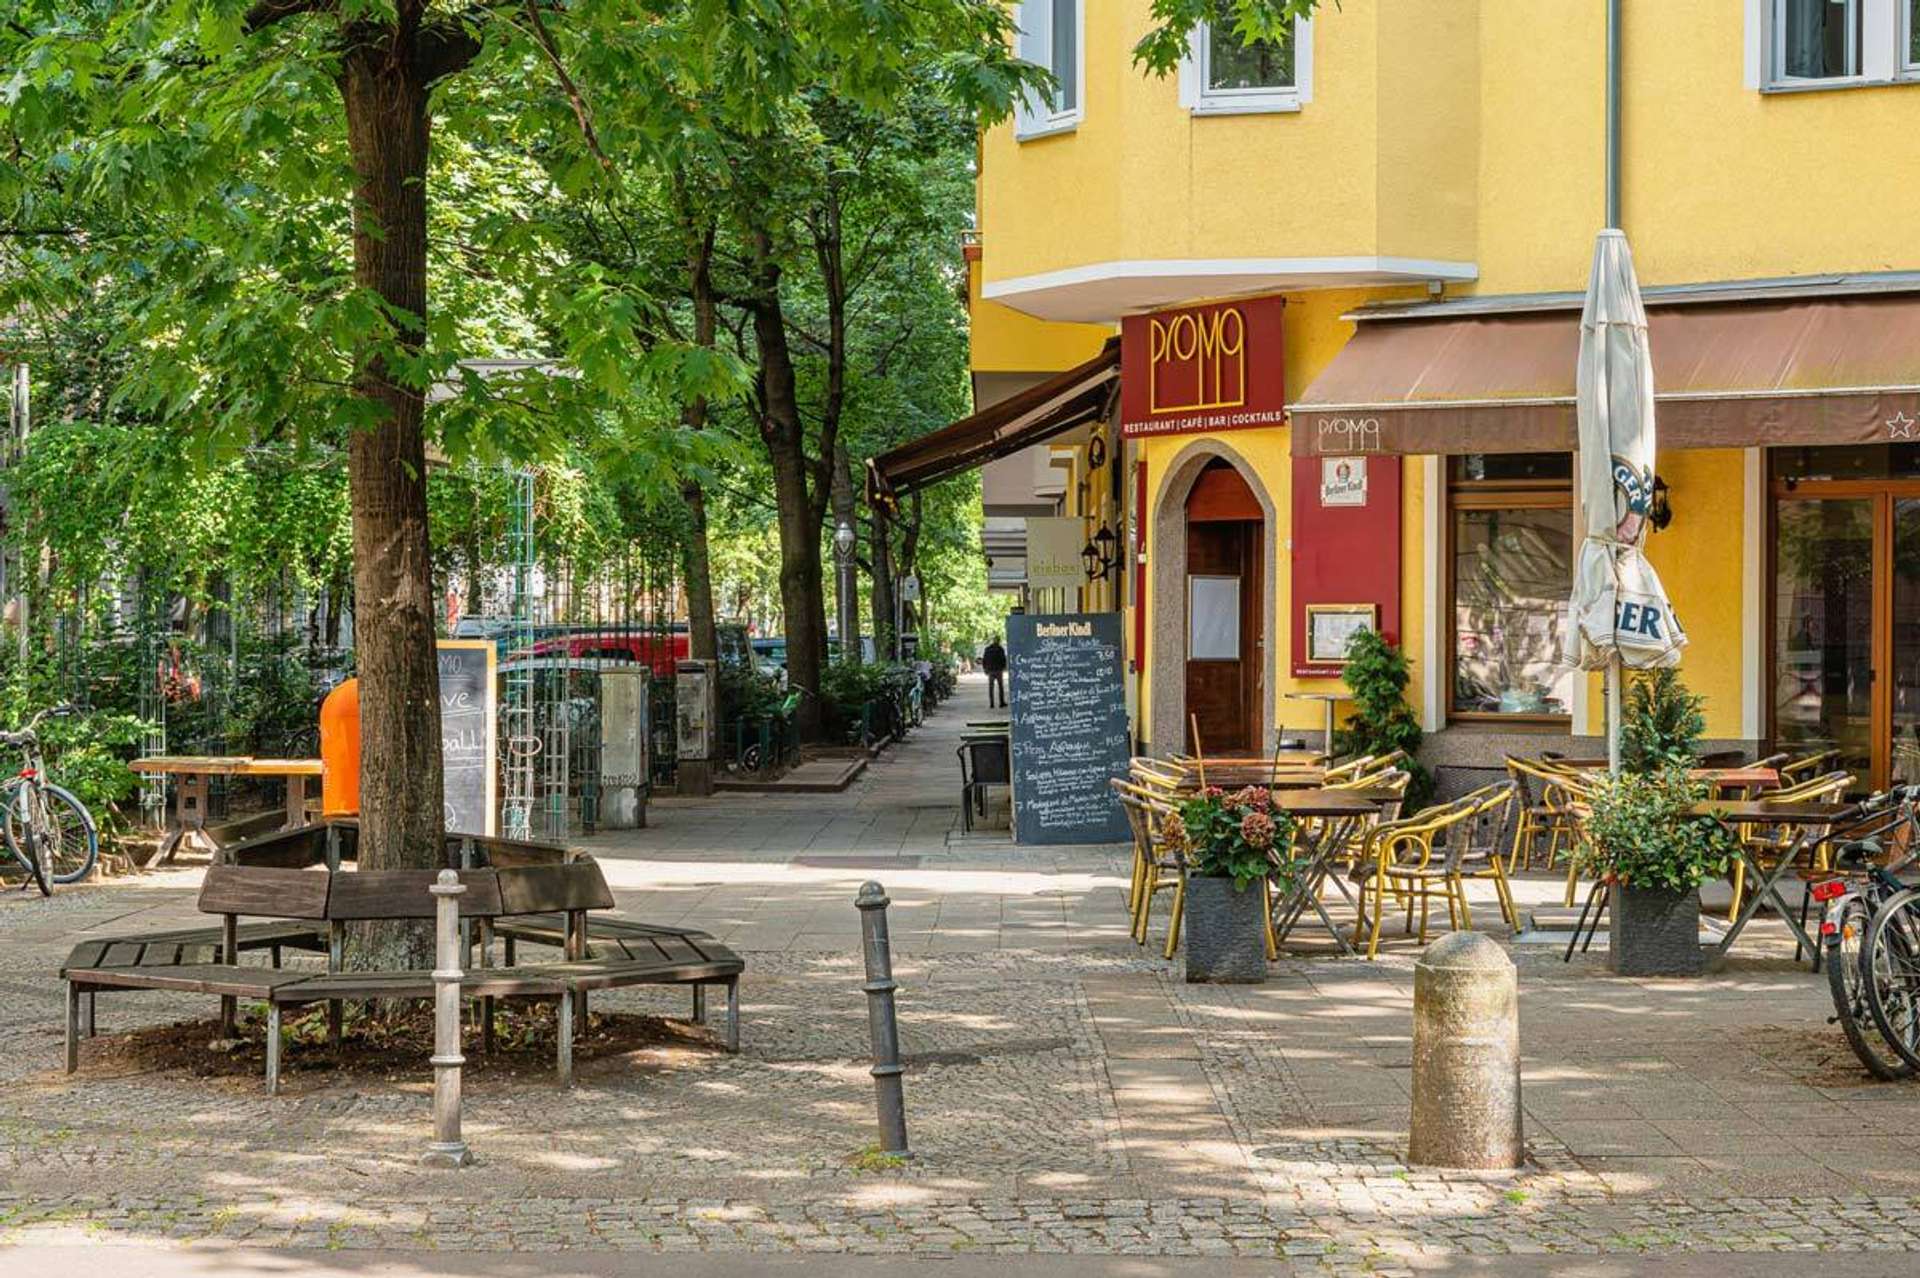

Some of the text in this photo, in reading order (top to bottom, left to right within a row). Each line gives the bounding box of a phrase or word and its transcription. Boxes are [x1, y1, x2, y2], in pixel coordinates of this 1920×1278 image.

[1124, 411, 1281, 433] RESTAURANT CAFÉ BAR COCKTAILS
[1036, 621, 1092, 637] Berliner Kindl
